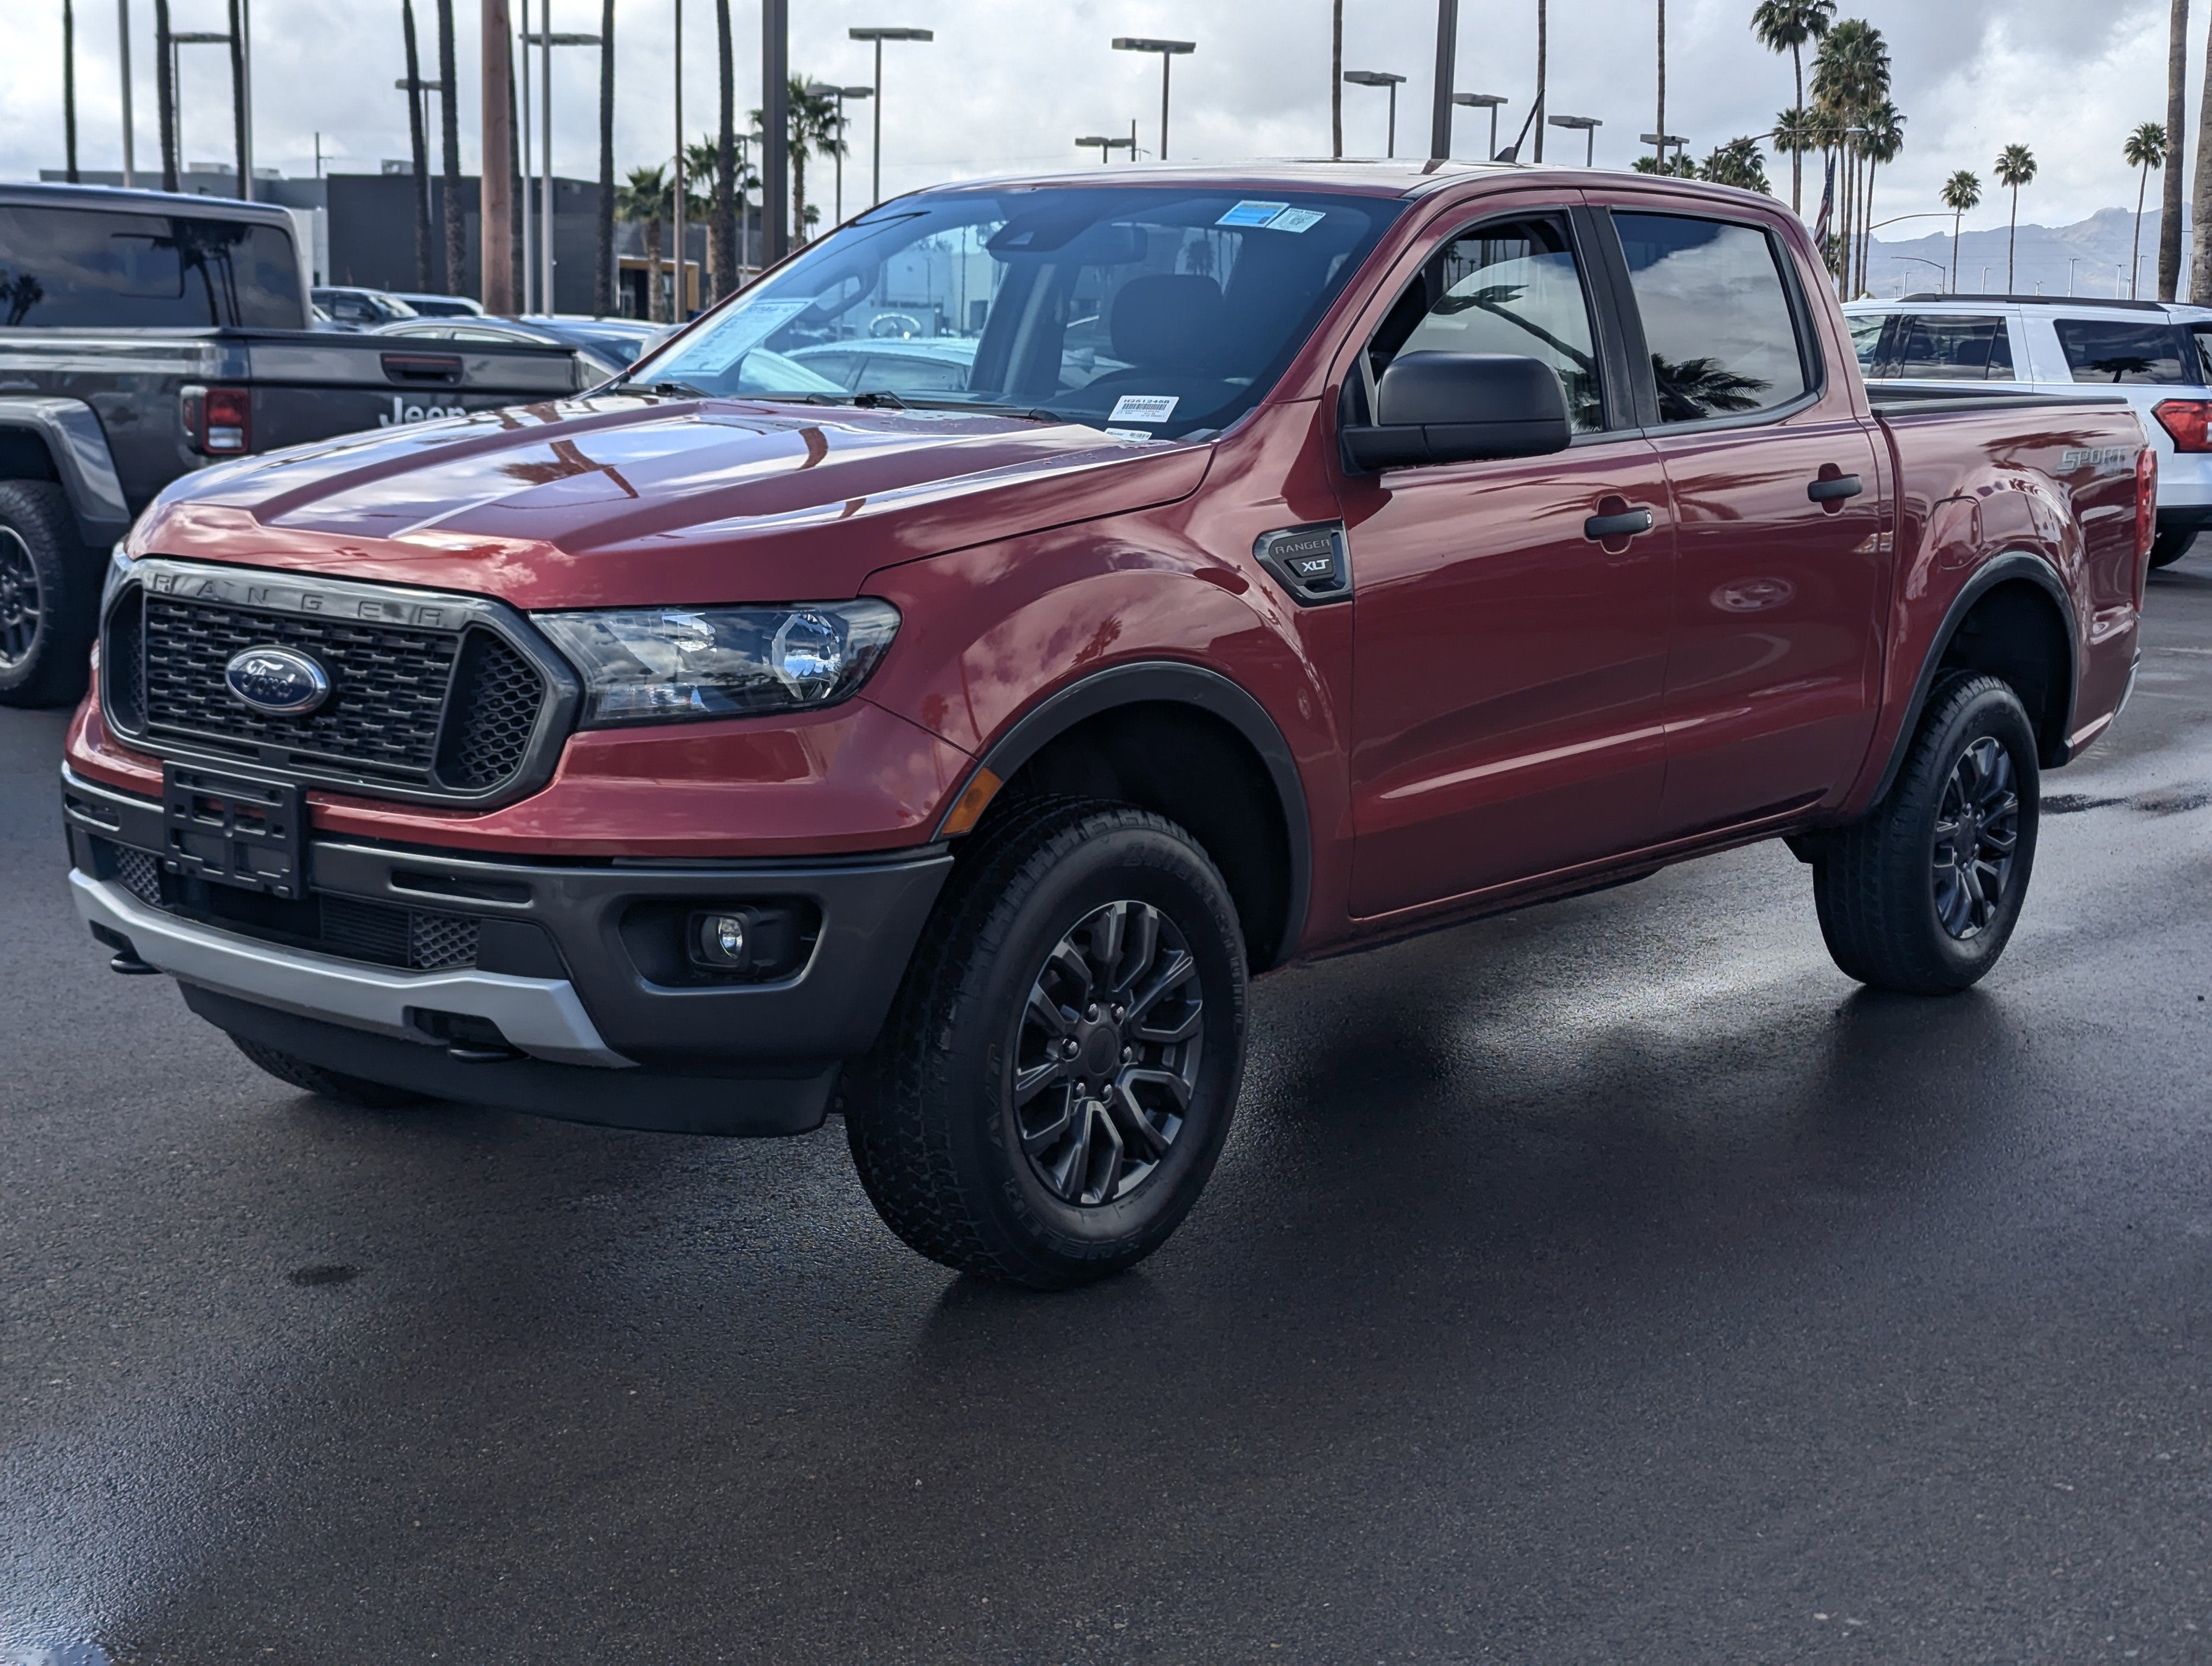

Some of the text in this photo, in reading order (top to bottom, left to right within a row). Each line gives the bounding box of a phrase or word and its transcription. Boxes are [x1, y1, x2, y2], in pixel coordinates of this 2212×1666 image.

[2057, 446, 2129, 473] SPORT
[1275, 539, 1330, 554] RANGER
[1302, 559, 1329, 572] XLT
[153, 573, 448, 625] RANGER
[242, 658, 296, 699] Ford
